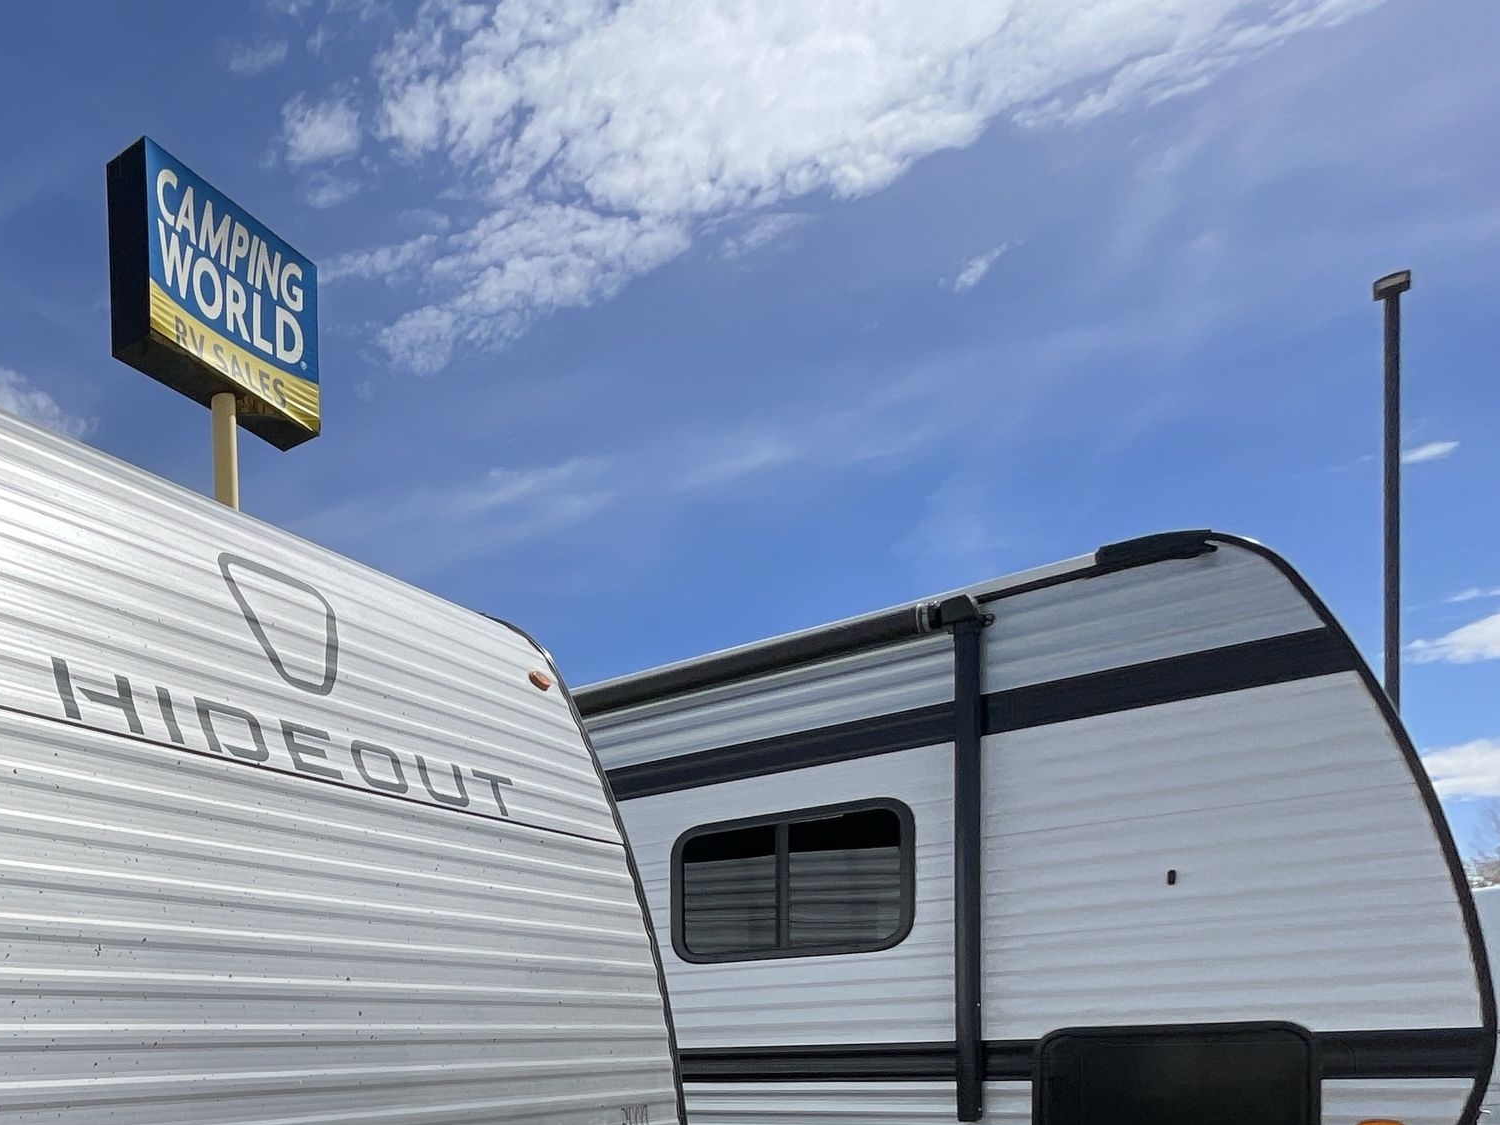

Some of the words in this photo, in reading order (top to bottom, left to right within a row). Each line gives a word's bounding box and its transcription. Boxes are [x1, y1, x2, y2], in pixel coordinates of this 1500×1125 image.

[156, 168, 303, 312] CAMPING
[157, 217, 305, 364] WORLD
[174, 315, 205, 358] RV
[50, 656, 514, 817] HIDEOUT
